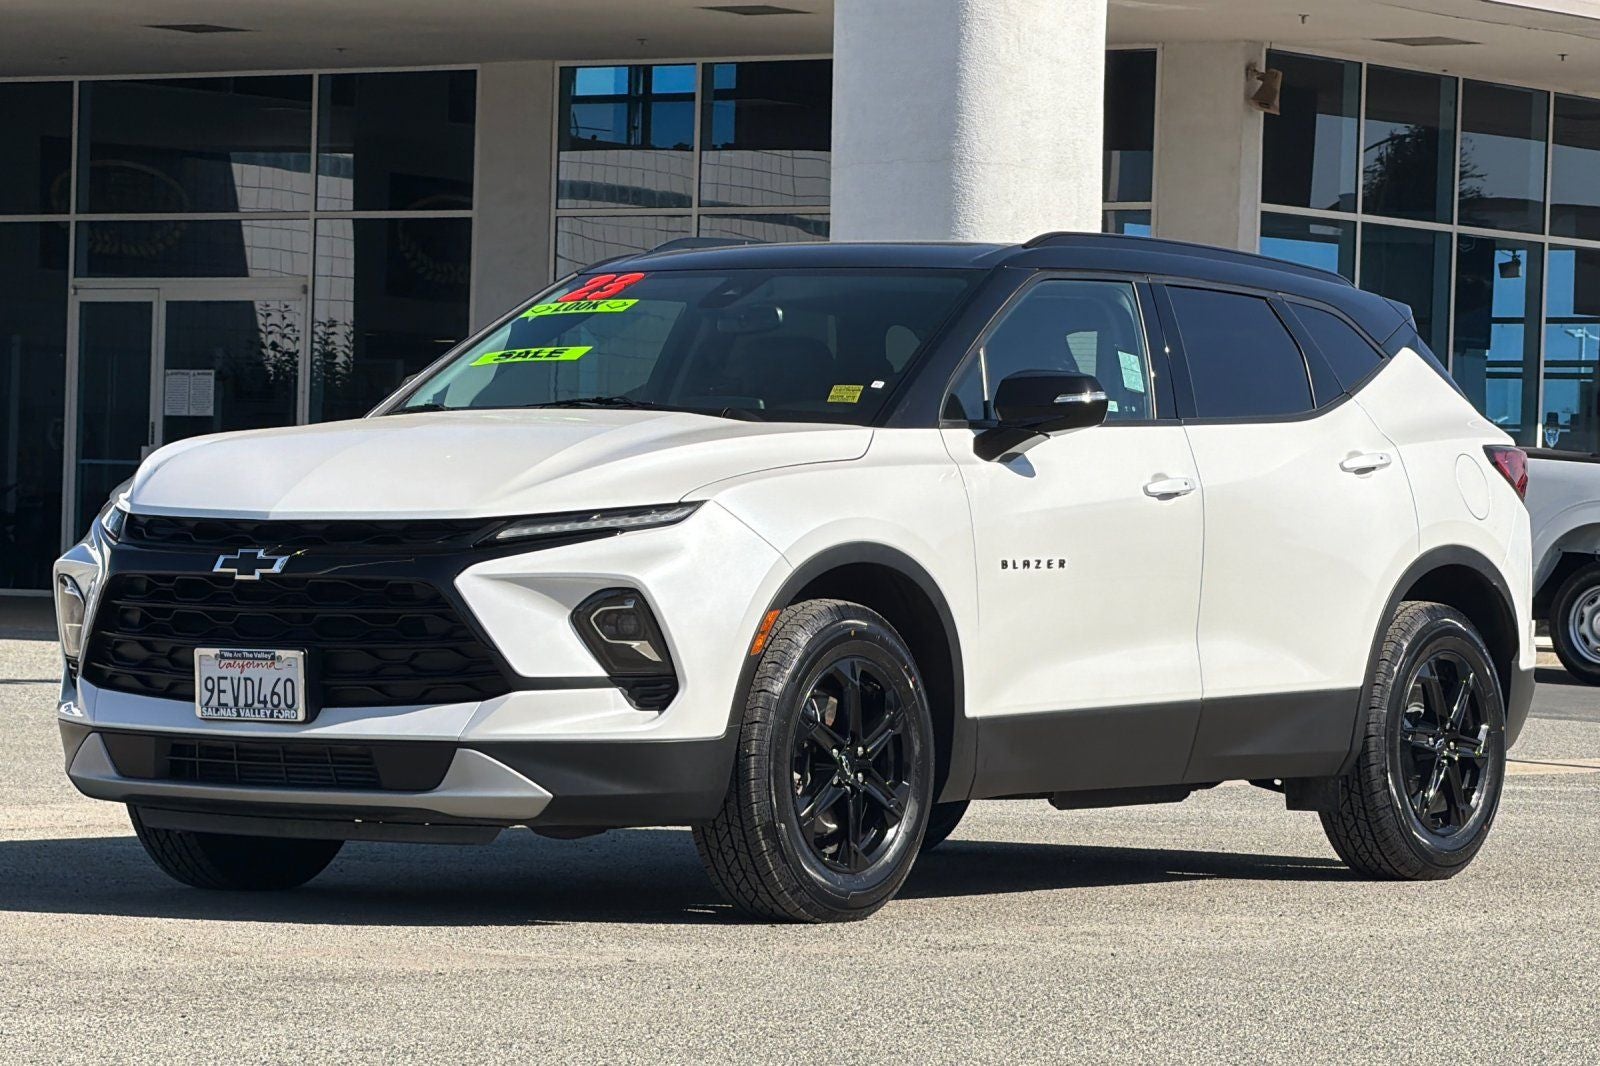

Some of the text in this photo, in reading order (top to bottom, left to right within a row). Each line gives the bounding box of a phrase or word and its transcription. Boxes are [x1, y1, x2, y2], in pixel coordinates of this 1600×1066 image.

[558, 272, 645, 302] 23
[551, 301, 605, 312] LOOK
[493, 348, 569, 361] SALE
[1001, 559, 1066, 569] BLAZER
[218, 660, 283, 674] California
[204, 676, 296, 709] 9EVD460
[240, 708, 271, 718] VALLEY
[273, 709, 297, 719] FORD
